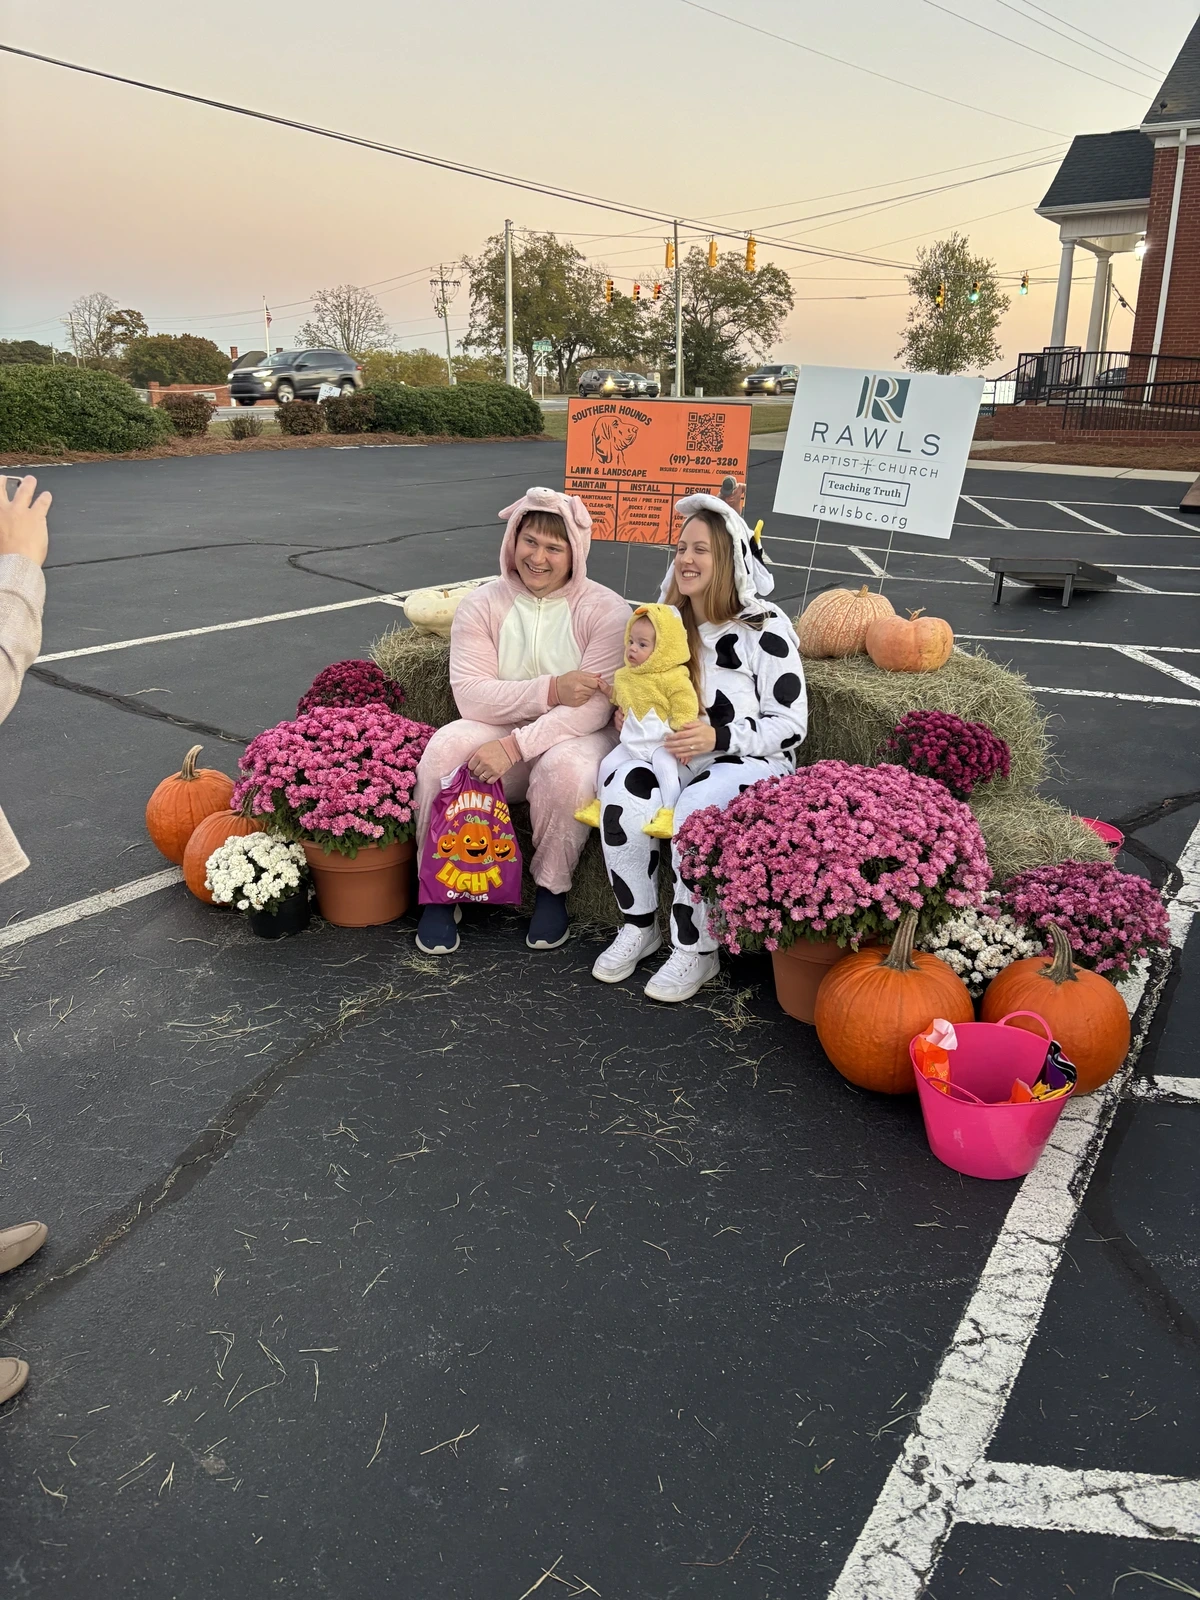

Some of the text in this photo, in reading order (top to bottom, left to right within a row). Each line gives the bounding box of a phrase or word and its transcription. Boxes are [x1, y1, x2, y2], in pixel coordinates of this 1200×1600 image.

[571, 404, 652, 426] SOUTHERN HOUNDS
[811, 421, 941, 456] RAWLS
[669, 453, 738, 467] (919)-820-3280
[803, 452, 939, 478] BAPTIST CHURCH
[570, 466, 592, 475] LAWN
[602, 468, 647, 478] LANDSCAPE
[571, 480, 607, 489] MAINTAIN
[630, 483, 661, 492] INSTALL
[828, 480, 902, 498] Teaching Truth
[812, 504, 908, 530] rawlsbc.org
[493, 808, 511, 825] THE
[436, 860, 503, 893] LIGHT
[446, 890, 460, 900] OF
